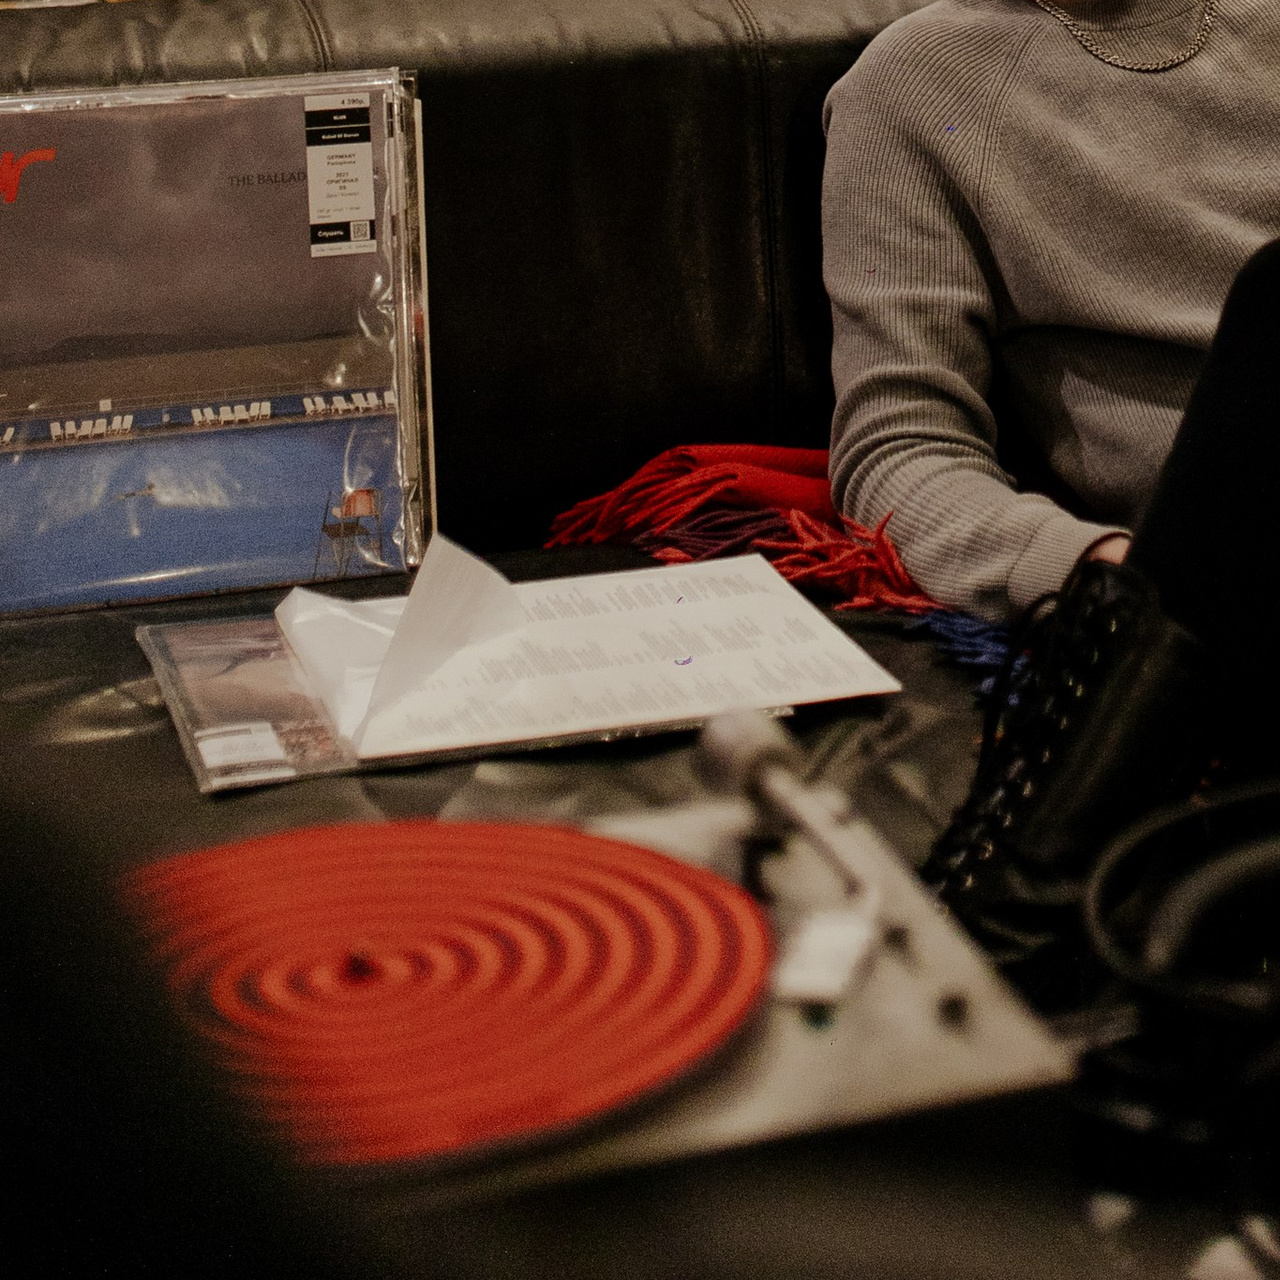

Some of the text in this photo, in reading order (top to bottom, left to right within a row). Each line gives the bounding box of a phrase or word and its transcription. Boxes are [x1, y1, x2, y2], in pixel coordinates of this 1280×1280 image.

[327, 153, 356, 161] GERMANY
[229, 170, 307, 187] THE BALLAD
[317, 230, 344, 238] Слушать
